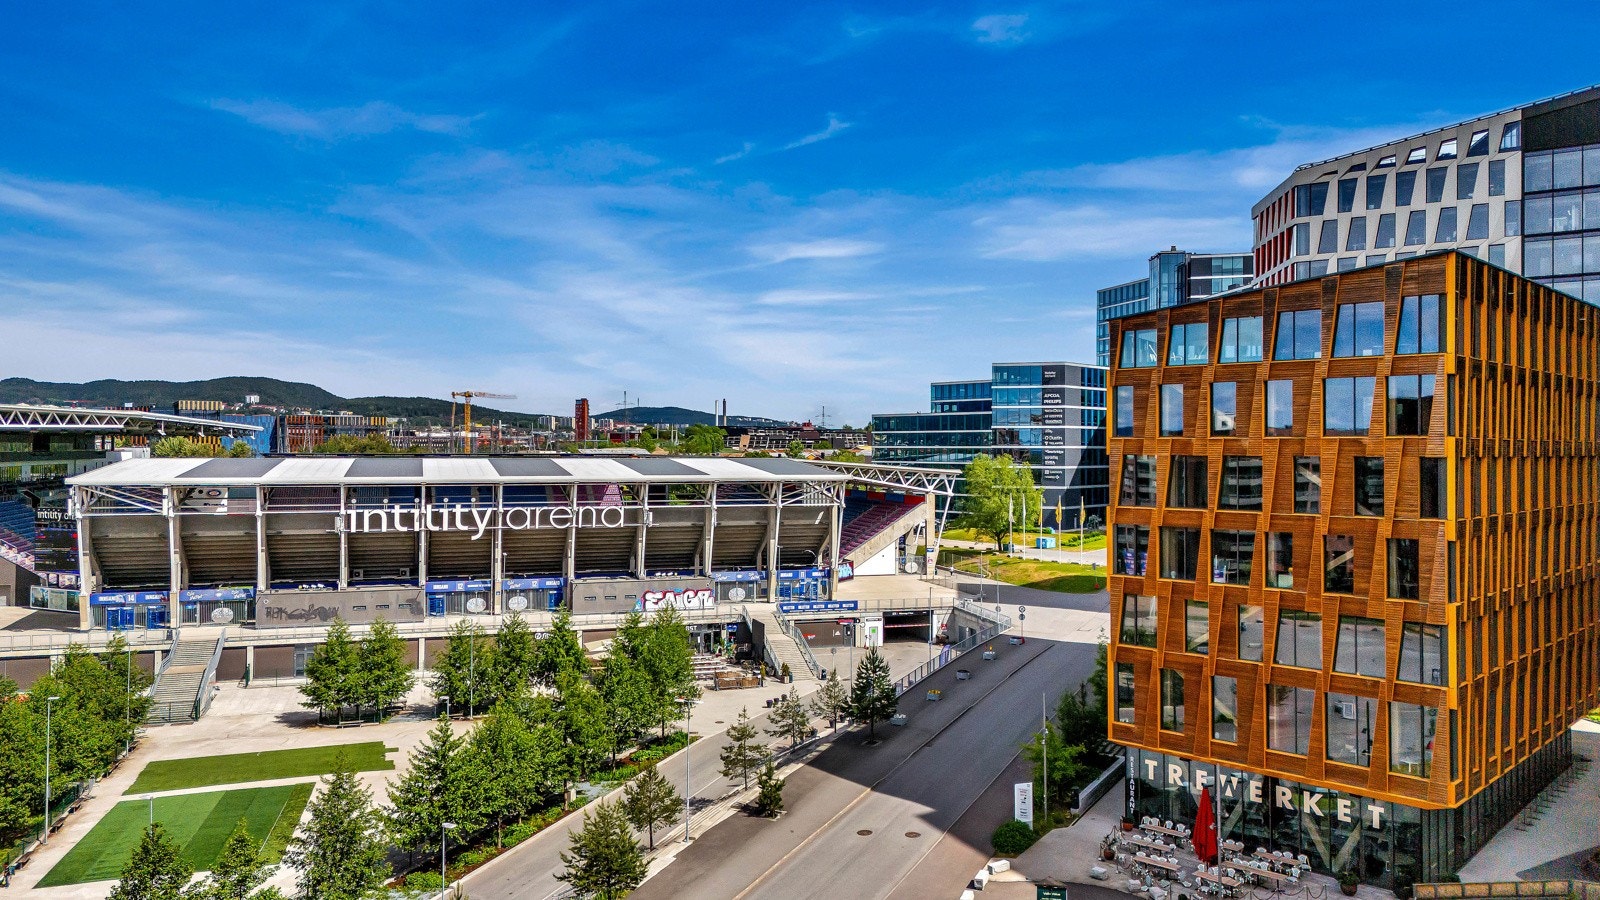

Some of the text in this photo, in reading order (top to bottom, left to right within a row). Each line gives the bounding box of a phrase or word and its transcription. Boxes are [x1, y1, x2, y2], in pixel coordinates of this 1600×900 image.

[37, 508, 61, 522] intility
[350, 498, 624, 541] intility arena
